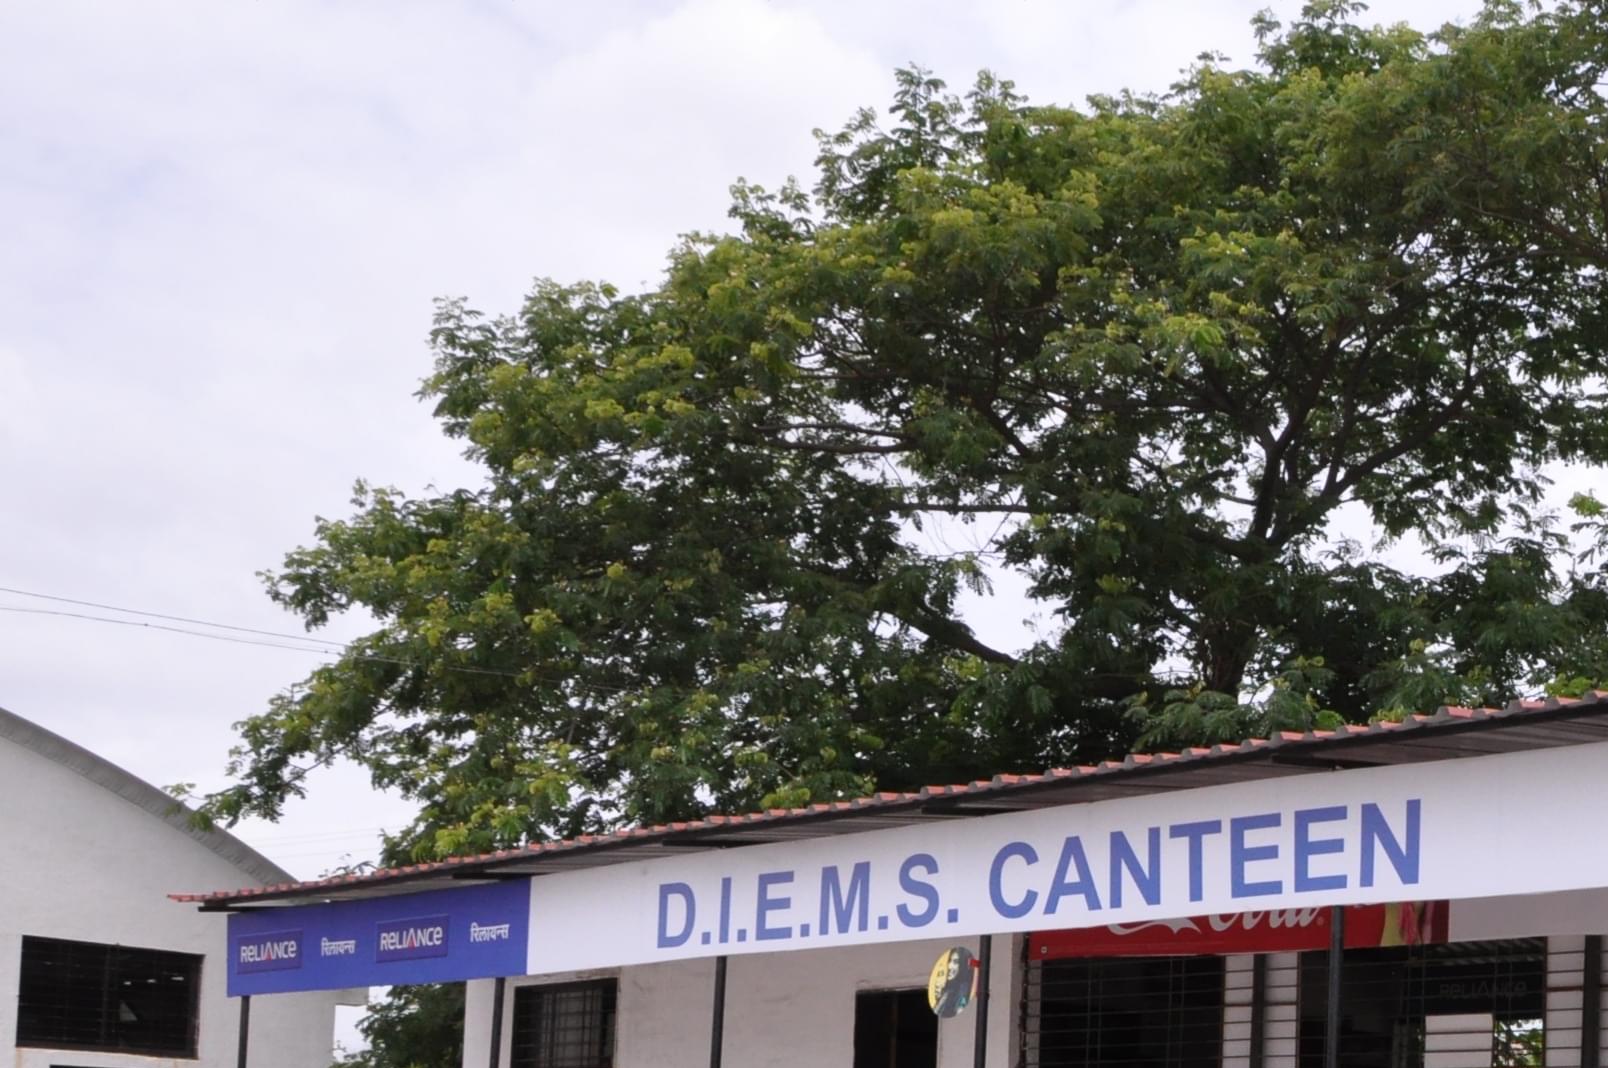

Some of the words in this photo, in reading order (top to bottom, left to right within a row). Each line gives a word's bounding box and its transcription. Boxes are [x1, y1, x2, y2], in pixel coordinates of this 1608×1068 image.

[656, 851, 959, 949] D.I.E.M.S.
[987, 799, 1422, 919] CANTEEN
[470, 922, 510, 943] रिलायन्स
